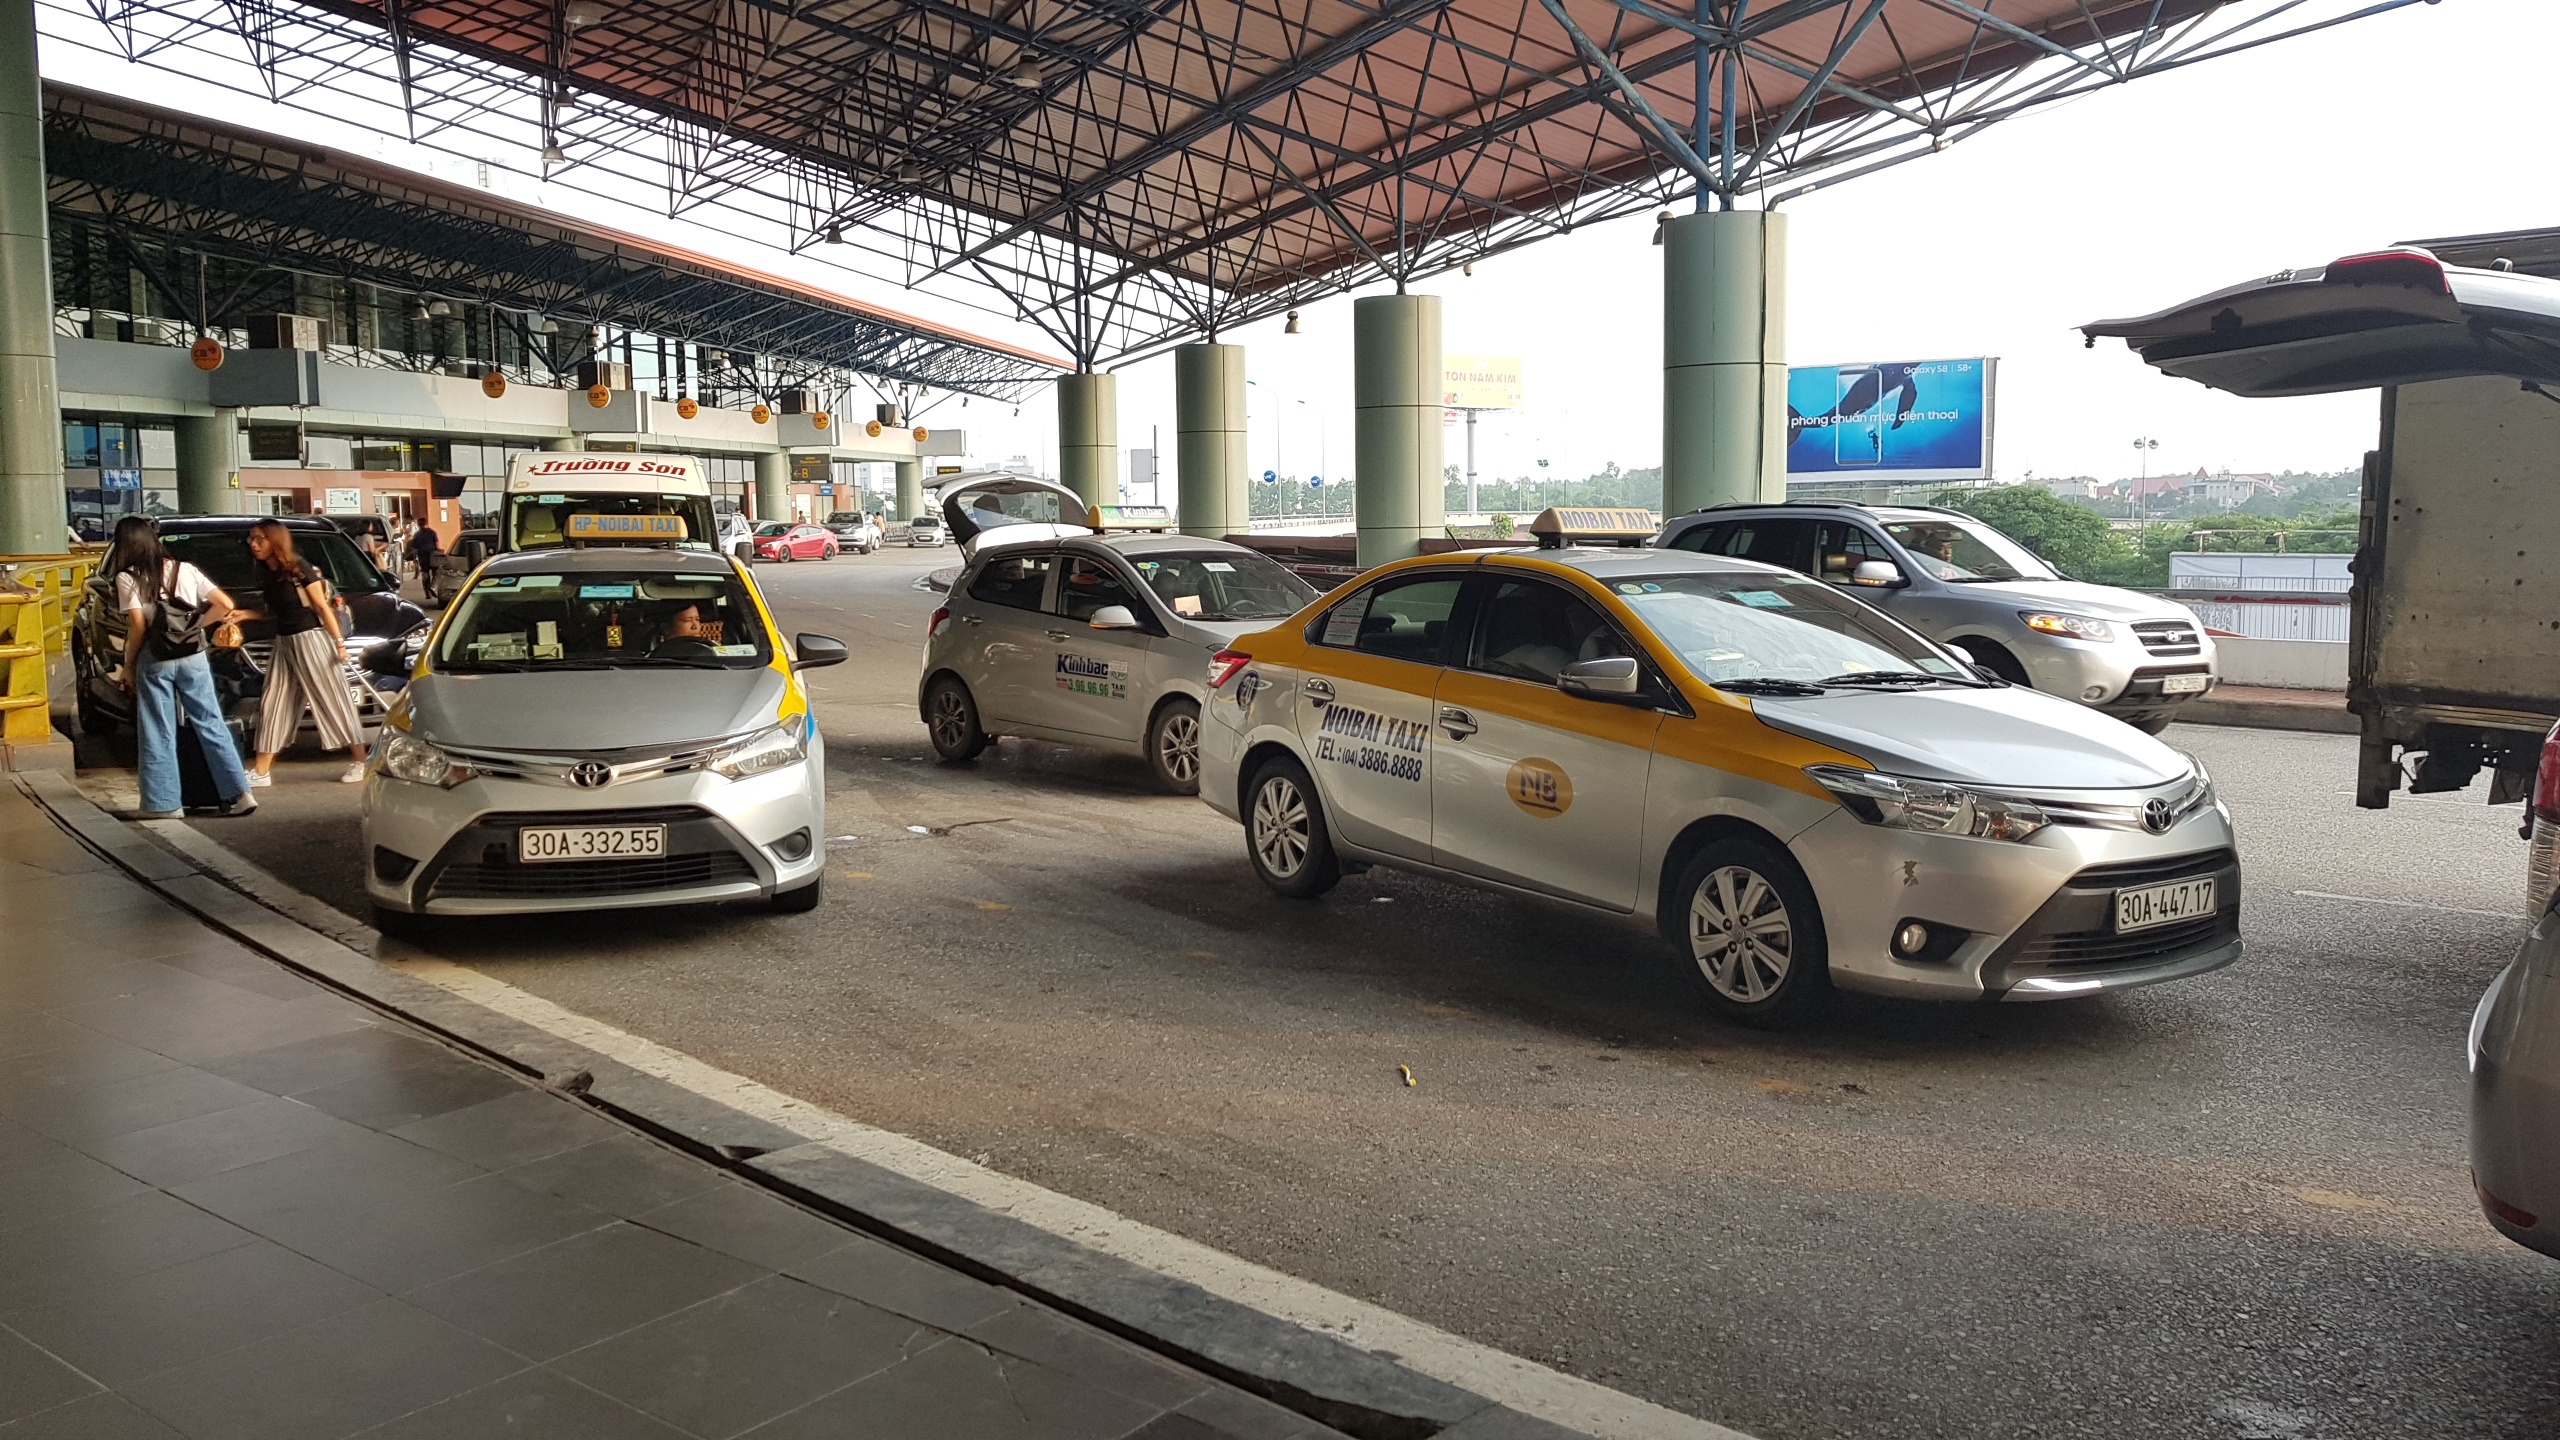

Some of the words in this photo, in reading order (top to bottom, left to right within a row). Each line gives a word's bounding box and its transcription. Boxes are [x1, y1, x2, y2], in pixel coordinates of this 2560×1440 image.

[1469, 372, 1494, 382] NAM
[1496, 374, 1516, 383] KIM
[1903, 366, 1936, 375] Galaxy
[1937, 365, 1948, 373] S8
[1957, 364, 1972, 372] S8+
[1791, 412, 1828, 428] phóng
[1830, 409, 1867, 424] chuẩn
[1869, 411, 1896, 424] mực
[1898, 409, 1925, 424] điện
[1927, 408, 1959, 423] thoại
[542, 457, 631, 472] Trường
[638, 460, 687, 476] Sơn
[802, 467, 809, 479] B
[230, 472, 239, 488] 4
[574, 516, 645, 532] HP-NOIBAI
[649, 517, 679, 532] TAXI
[1559, 511, 1617, 529] NOIBAI
[1615, 511, 1654, 530] TAXI
[1057, 653, 1109, 676] Kinhbac
[1111, 682, 1126, 691] TAXI
[1321, 703, 1384, 742] NOIBAI
[1385, 716, 1429, 753] TAXI
[1342, 747, 1358, 767] (04)
[1358, 746, 1422, 782] 3886.8888
[1520, 770, 1558, 803] NB
[527, 829, 660, 856] 30A-332.55
[2121, 881, 2213, 925] 30A-447.17
